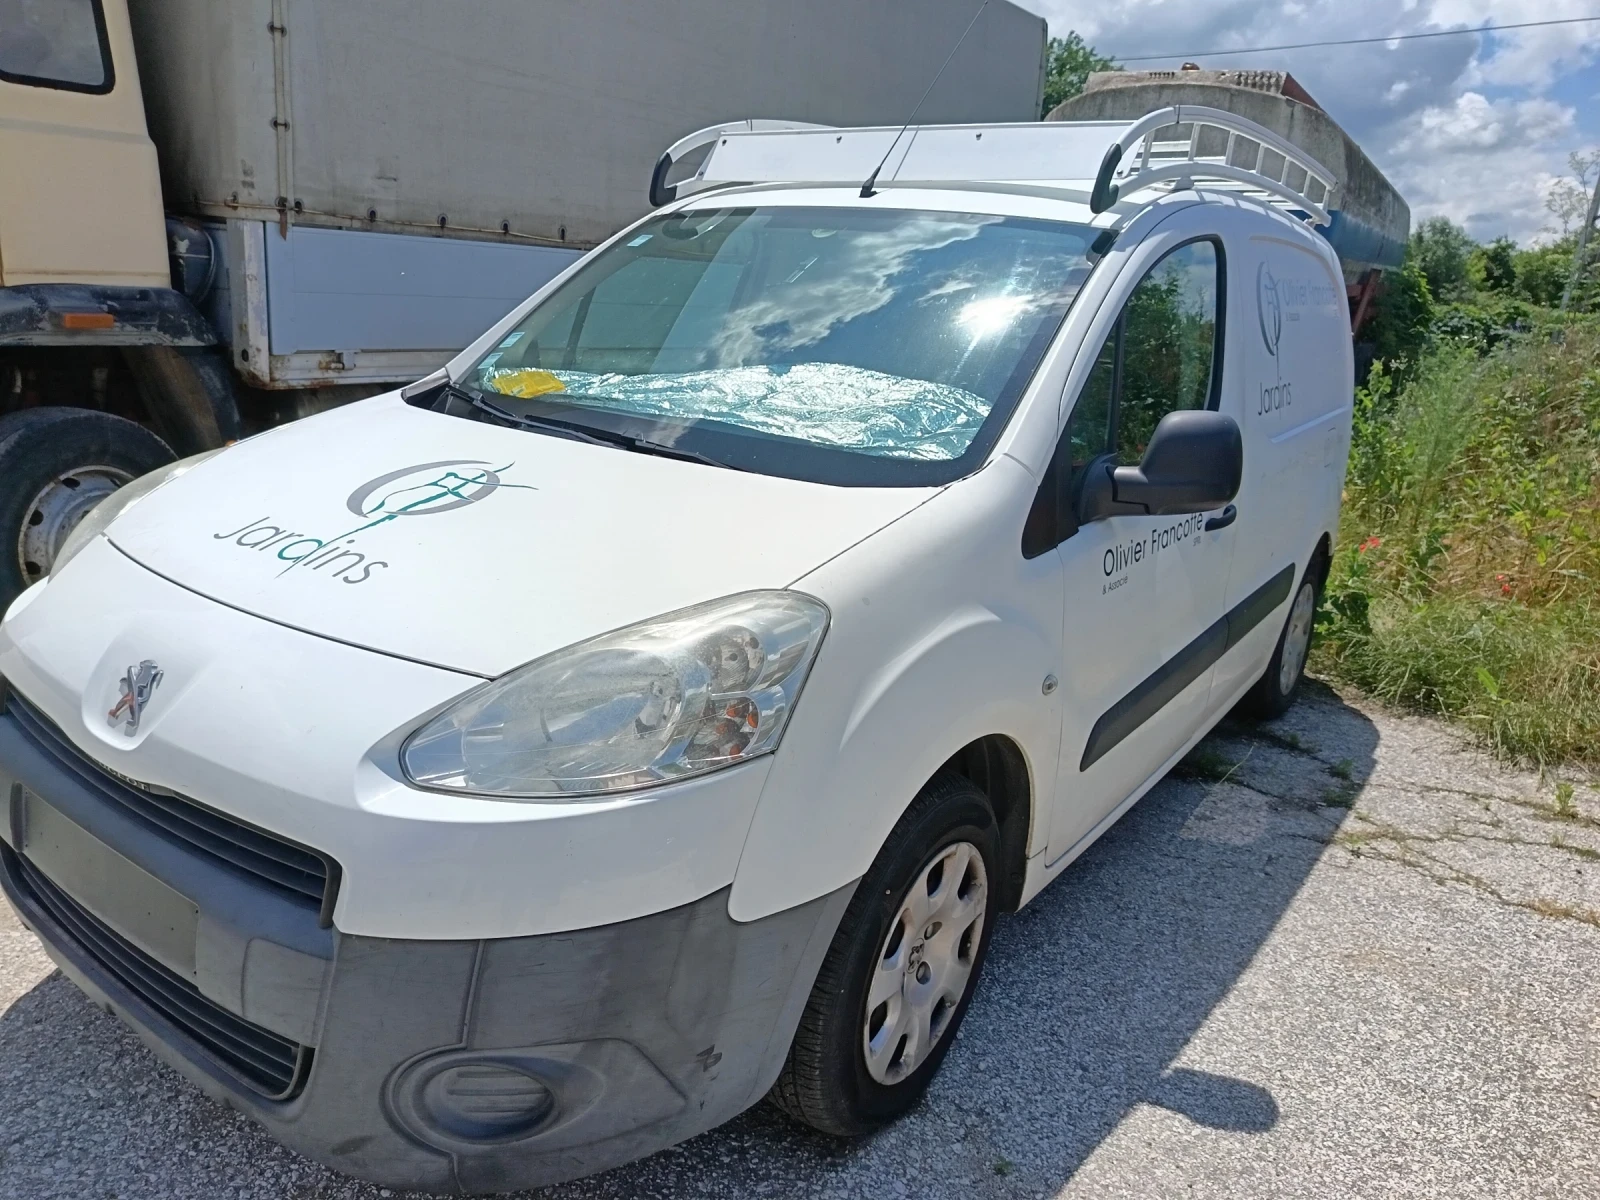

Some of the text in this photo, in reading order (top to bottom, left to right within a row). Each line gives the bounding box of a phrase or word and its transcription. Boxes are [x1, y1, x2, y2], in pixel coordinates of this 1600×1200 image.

[1258, 376, 1292, 416] Jardins
[213, 515, 389, 585] Jardins
[1103, 512, 1203, 577] Olivier Francotte
